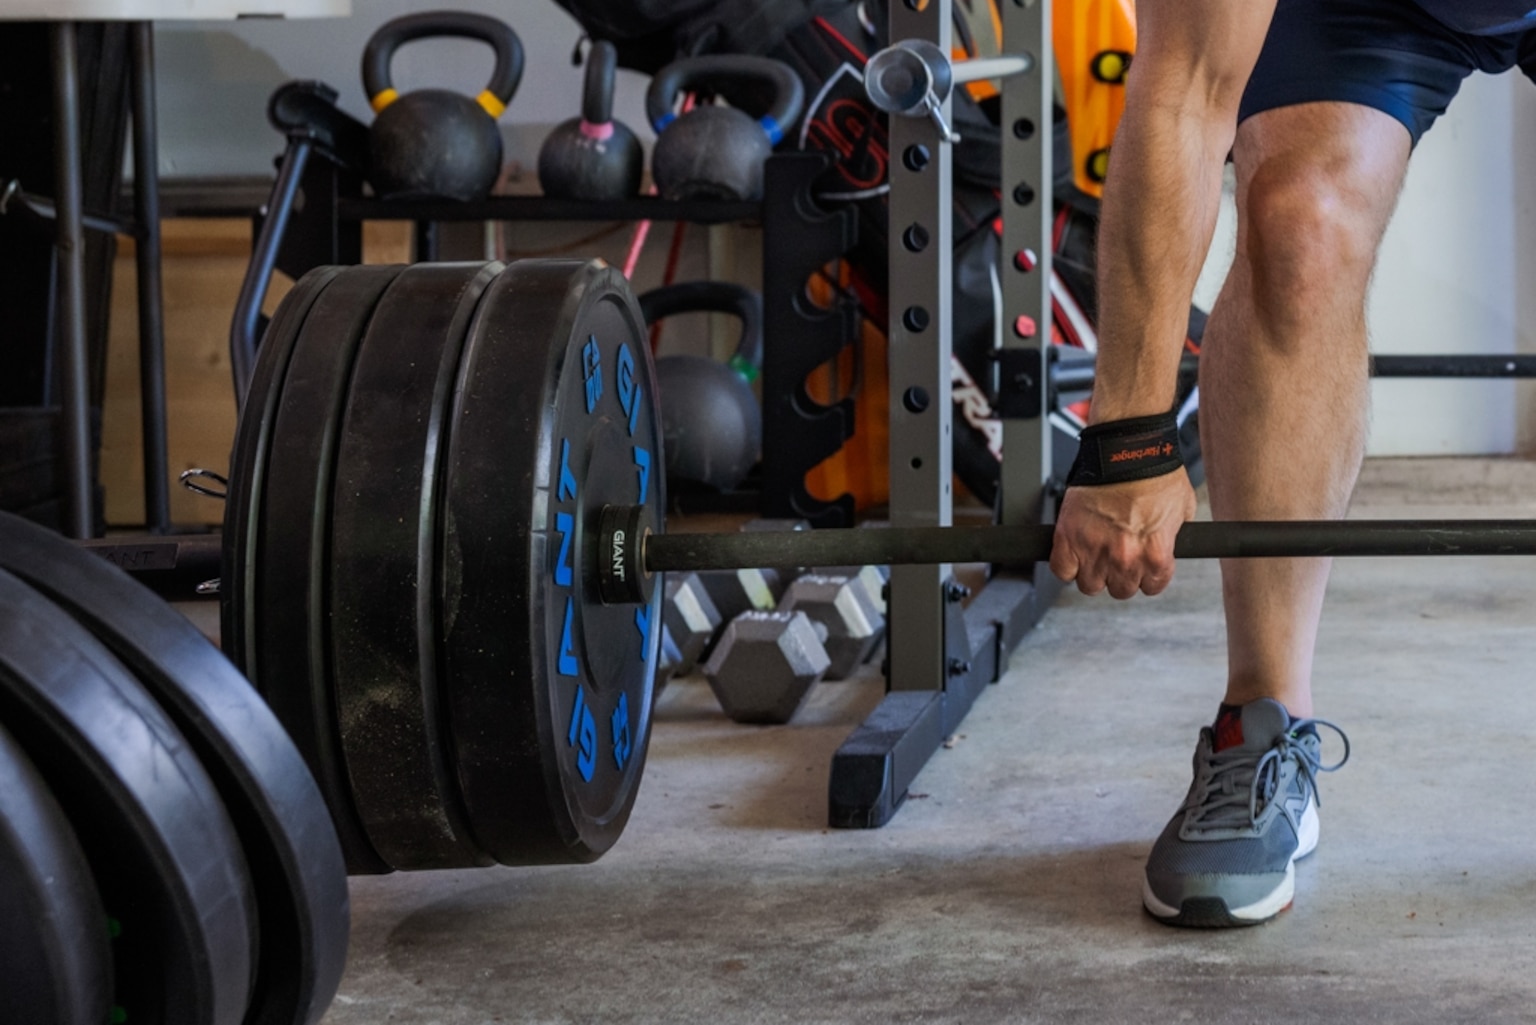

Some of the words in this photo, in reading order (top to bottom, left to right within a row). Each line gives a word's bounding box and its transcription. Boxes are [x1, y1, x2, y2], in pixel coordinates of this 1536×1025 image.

[617, 342, 651, 662] GIAT
[1110, 444, 1161, 463] Harbinger
[555, 437, 597, 783] GIANT
[613, 530, 625, 578] GIANT
